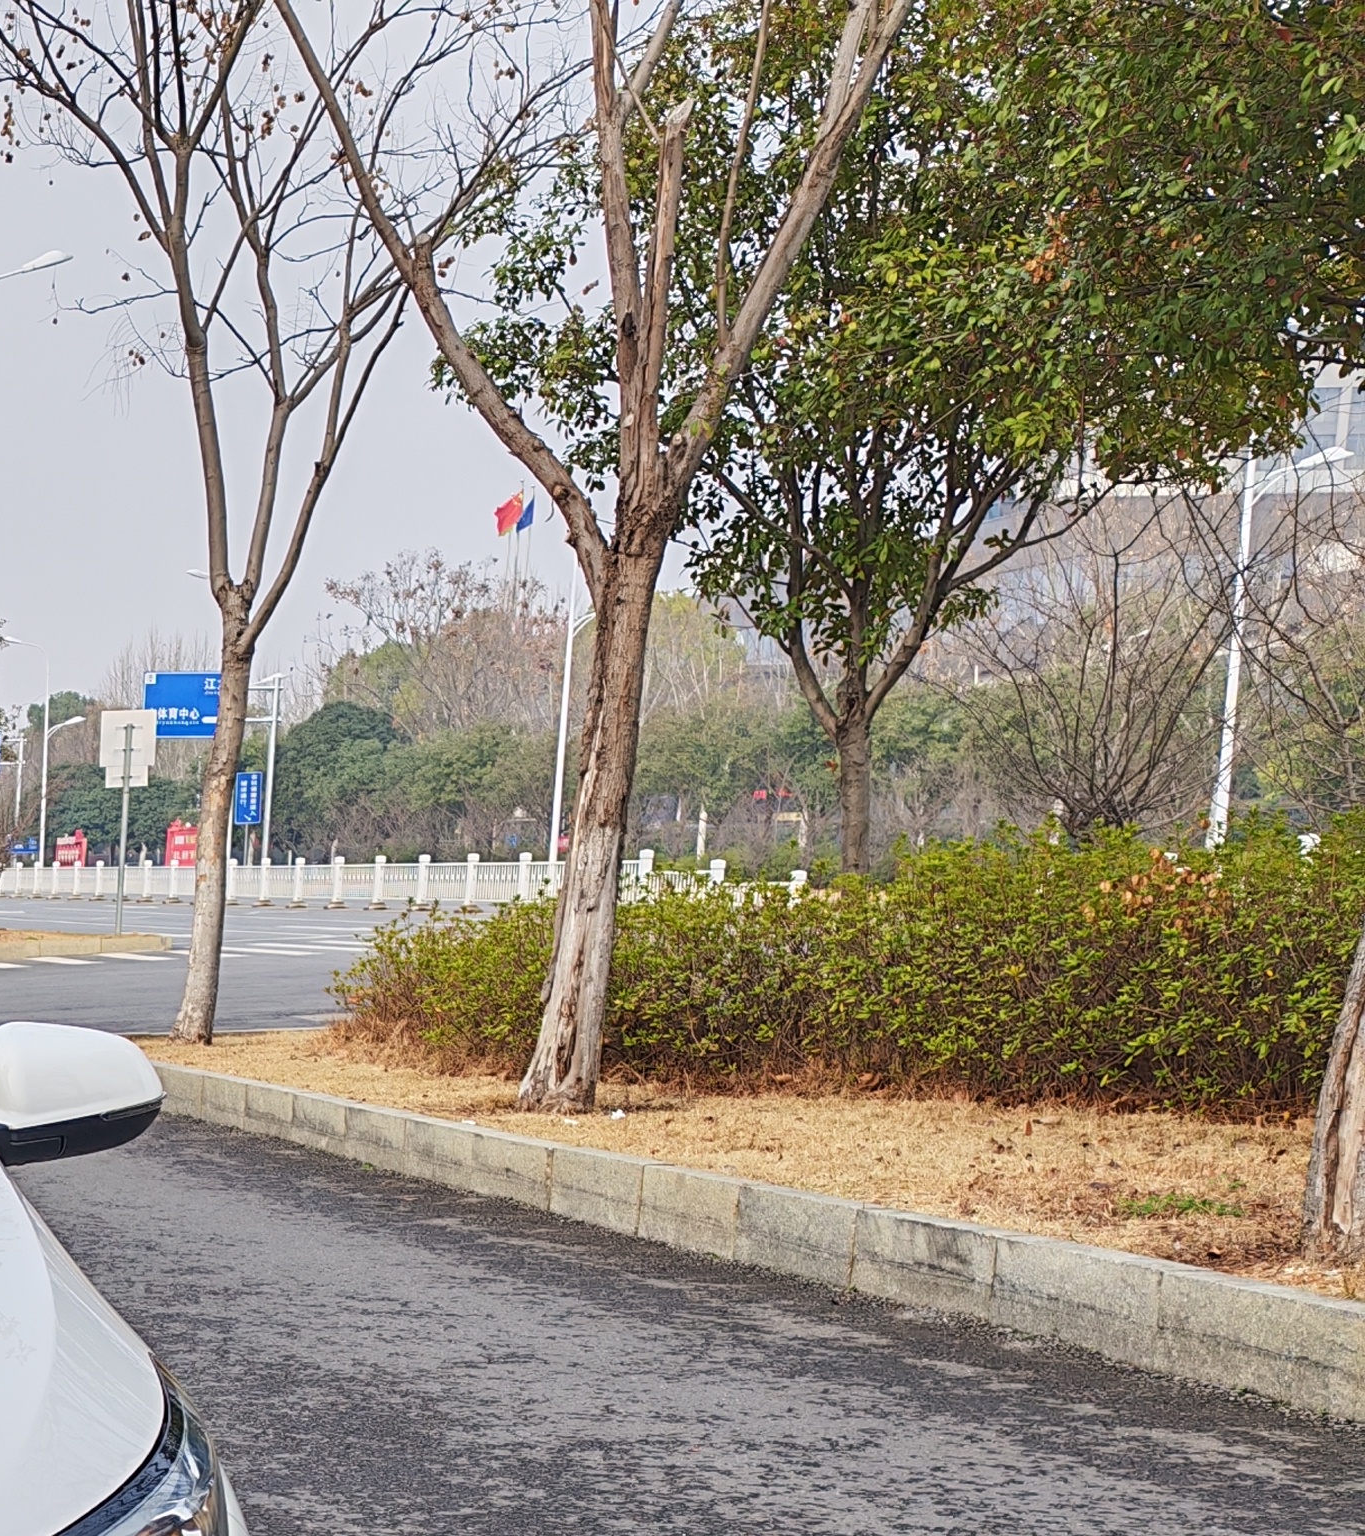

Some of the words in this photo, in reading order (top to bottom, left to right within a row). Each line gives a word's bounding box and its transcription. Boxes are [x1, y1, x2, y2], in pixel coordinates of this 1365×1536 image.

[204, 677, 221, 690] 江
[150, 706, 200, 720] 体育中心
